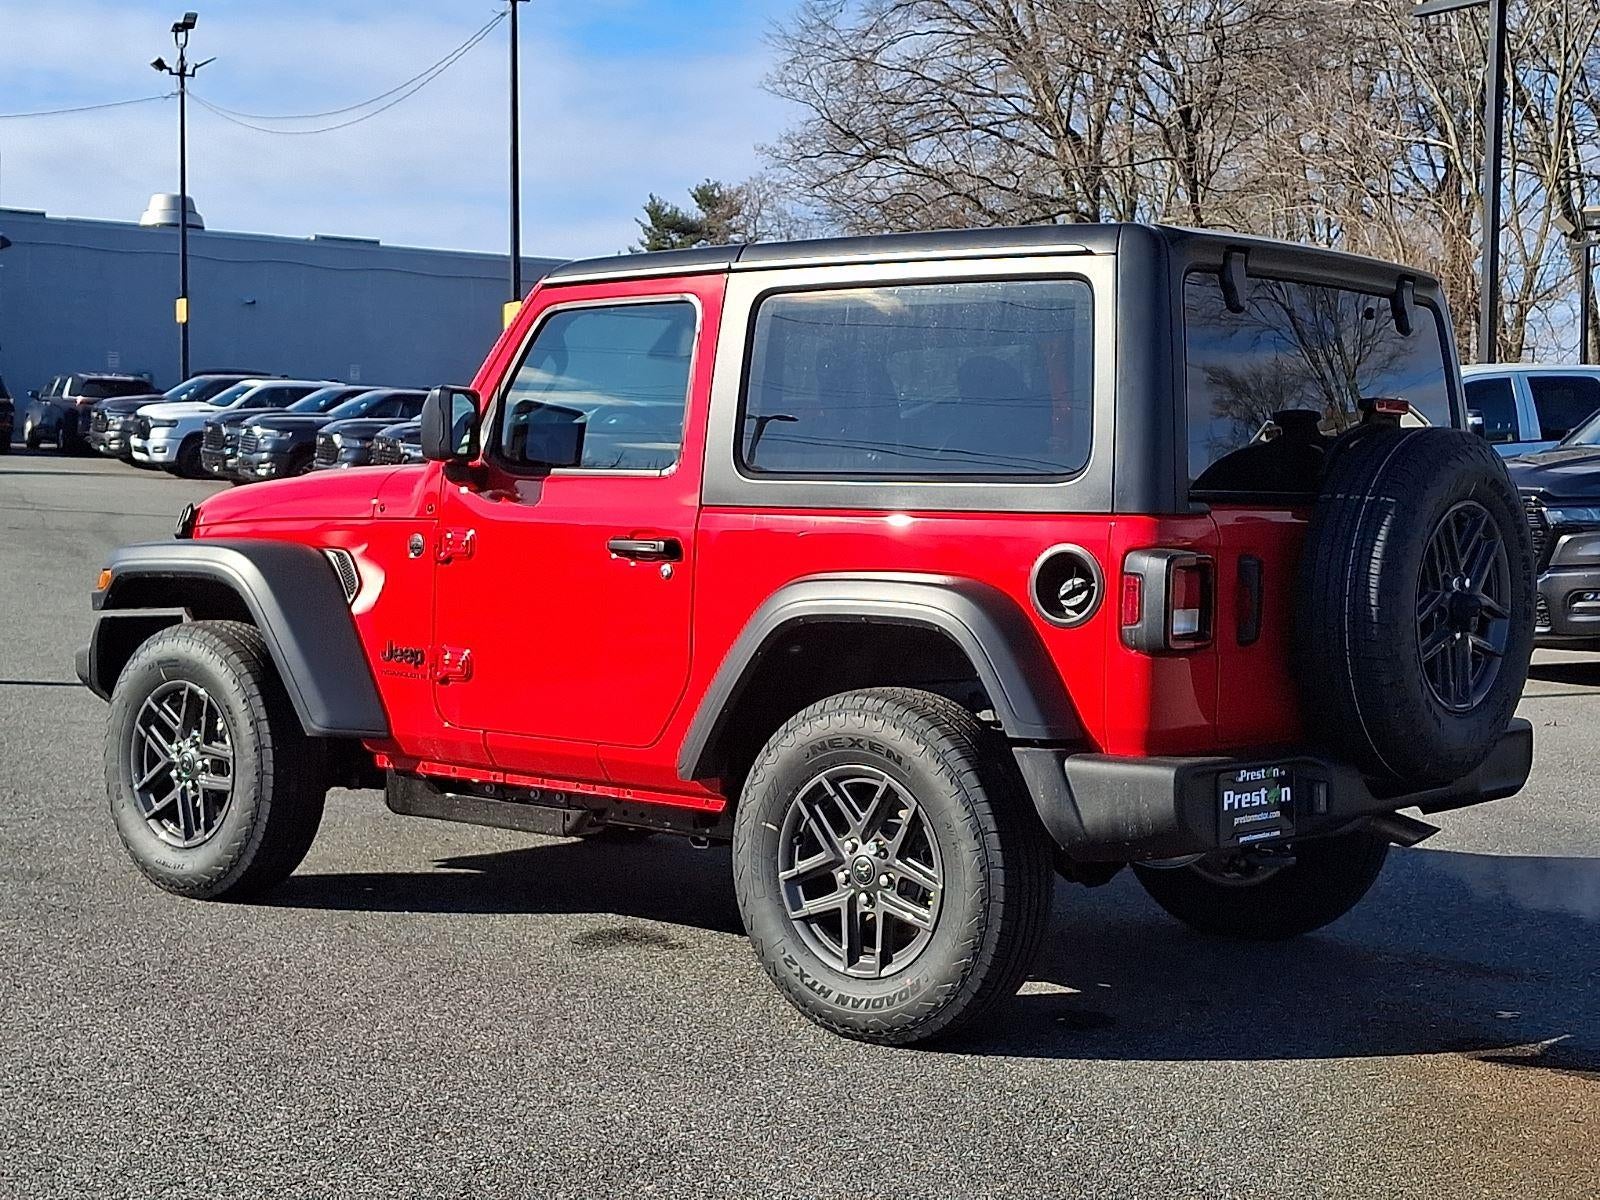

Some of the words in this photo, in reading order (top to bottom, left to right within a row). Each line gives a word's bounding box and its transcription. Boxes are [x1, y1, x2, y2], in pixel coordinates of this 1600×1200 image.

[380, 639, 425, 669] Jeep
[809, 736, 903, 767] NEXEN
[1223, 785, 1291, 811] Preston
[782, 953, 834, 999] HTX2
[834, 977, 921, 1010] ROADIAN
